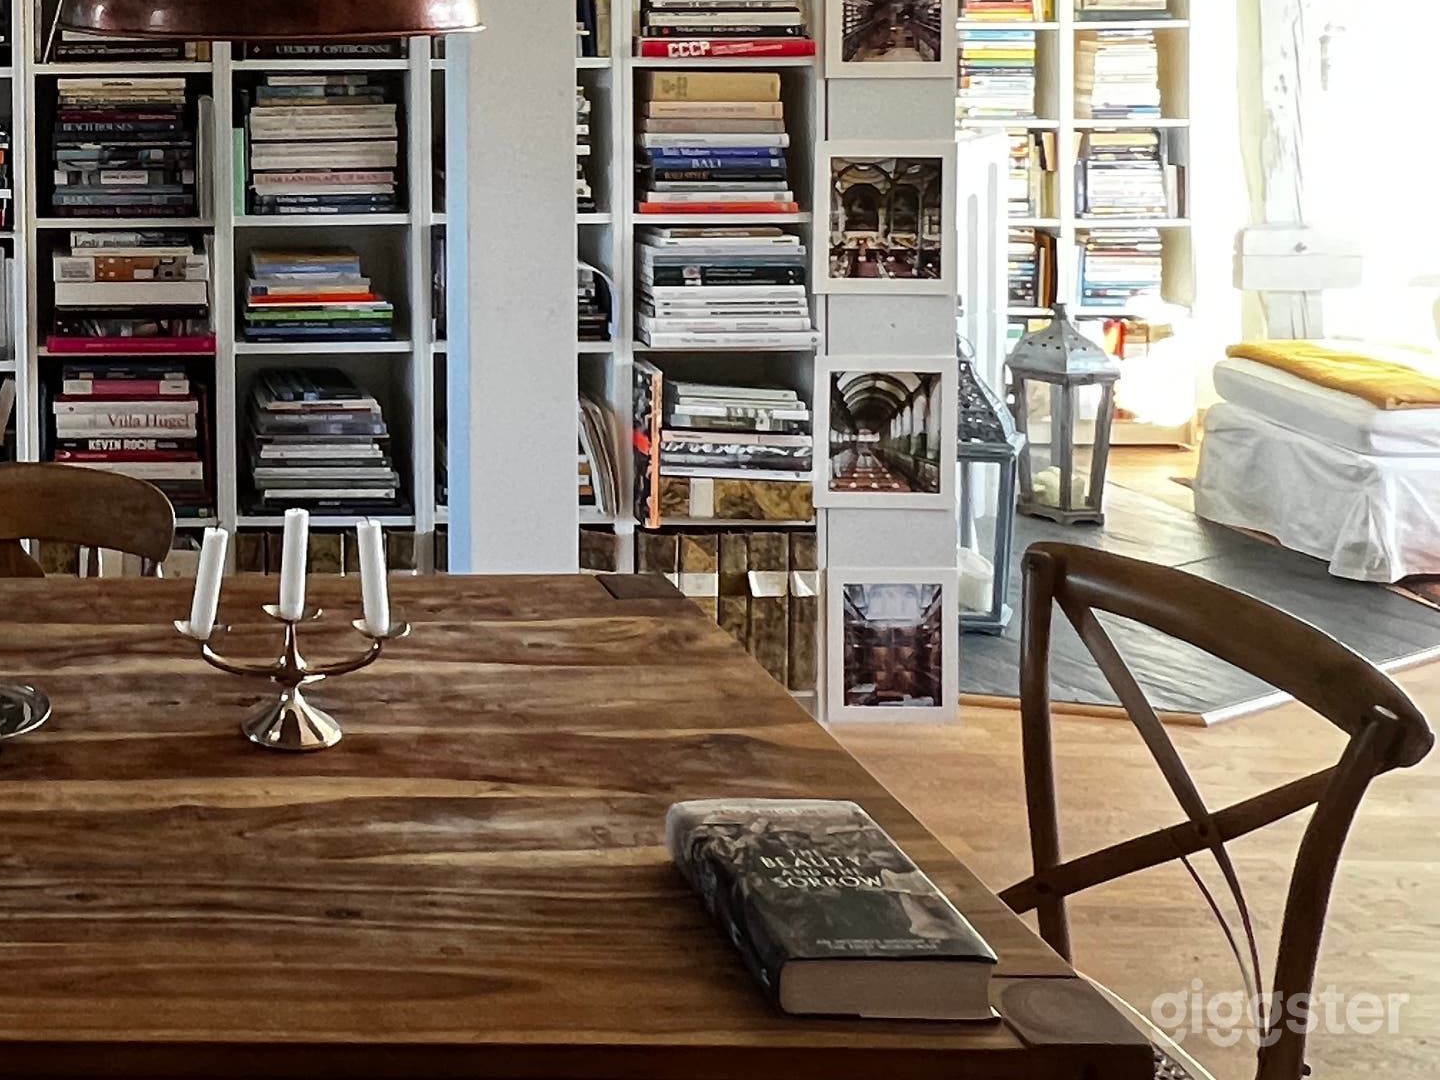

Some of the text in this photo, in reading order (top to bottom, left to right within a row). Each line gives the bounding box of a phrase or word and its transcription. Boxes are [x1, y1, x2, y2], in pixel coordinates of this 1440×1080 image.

[109, 414, 141, 428] Villa
[88, 439, 157, 451] KEVIN ROCHE
[760, 855, 862, 869] BEAUTY
[771, 874, 882, 889] SORROW
